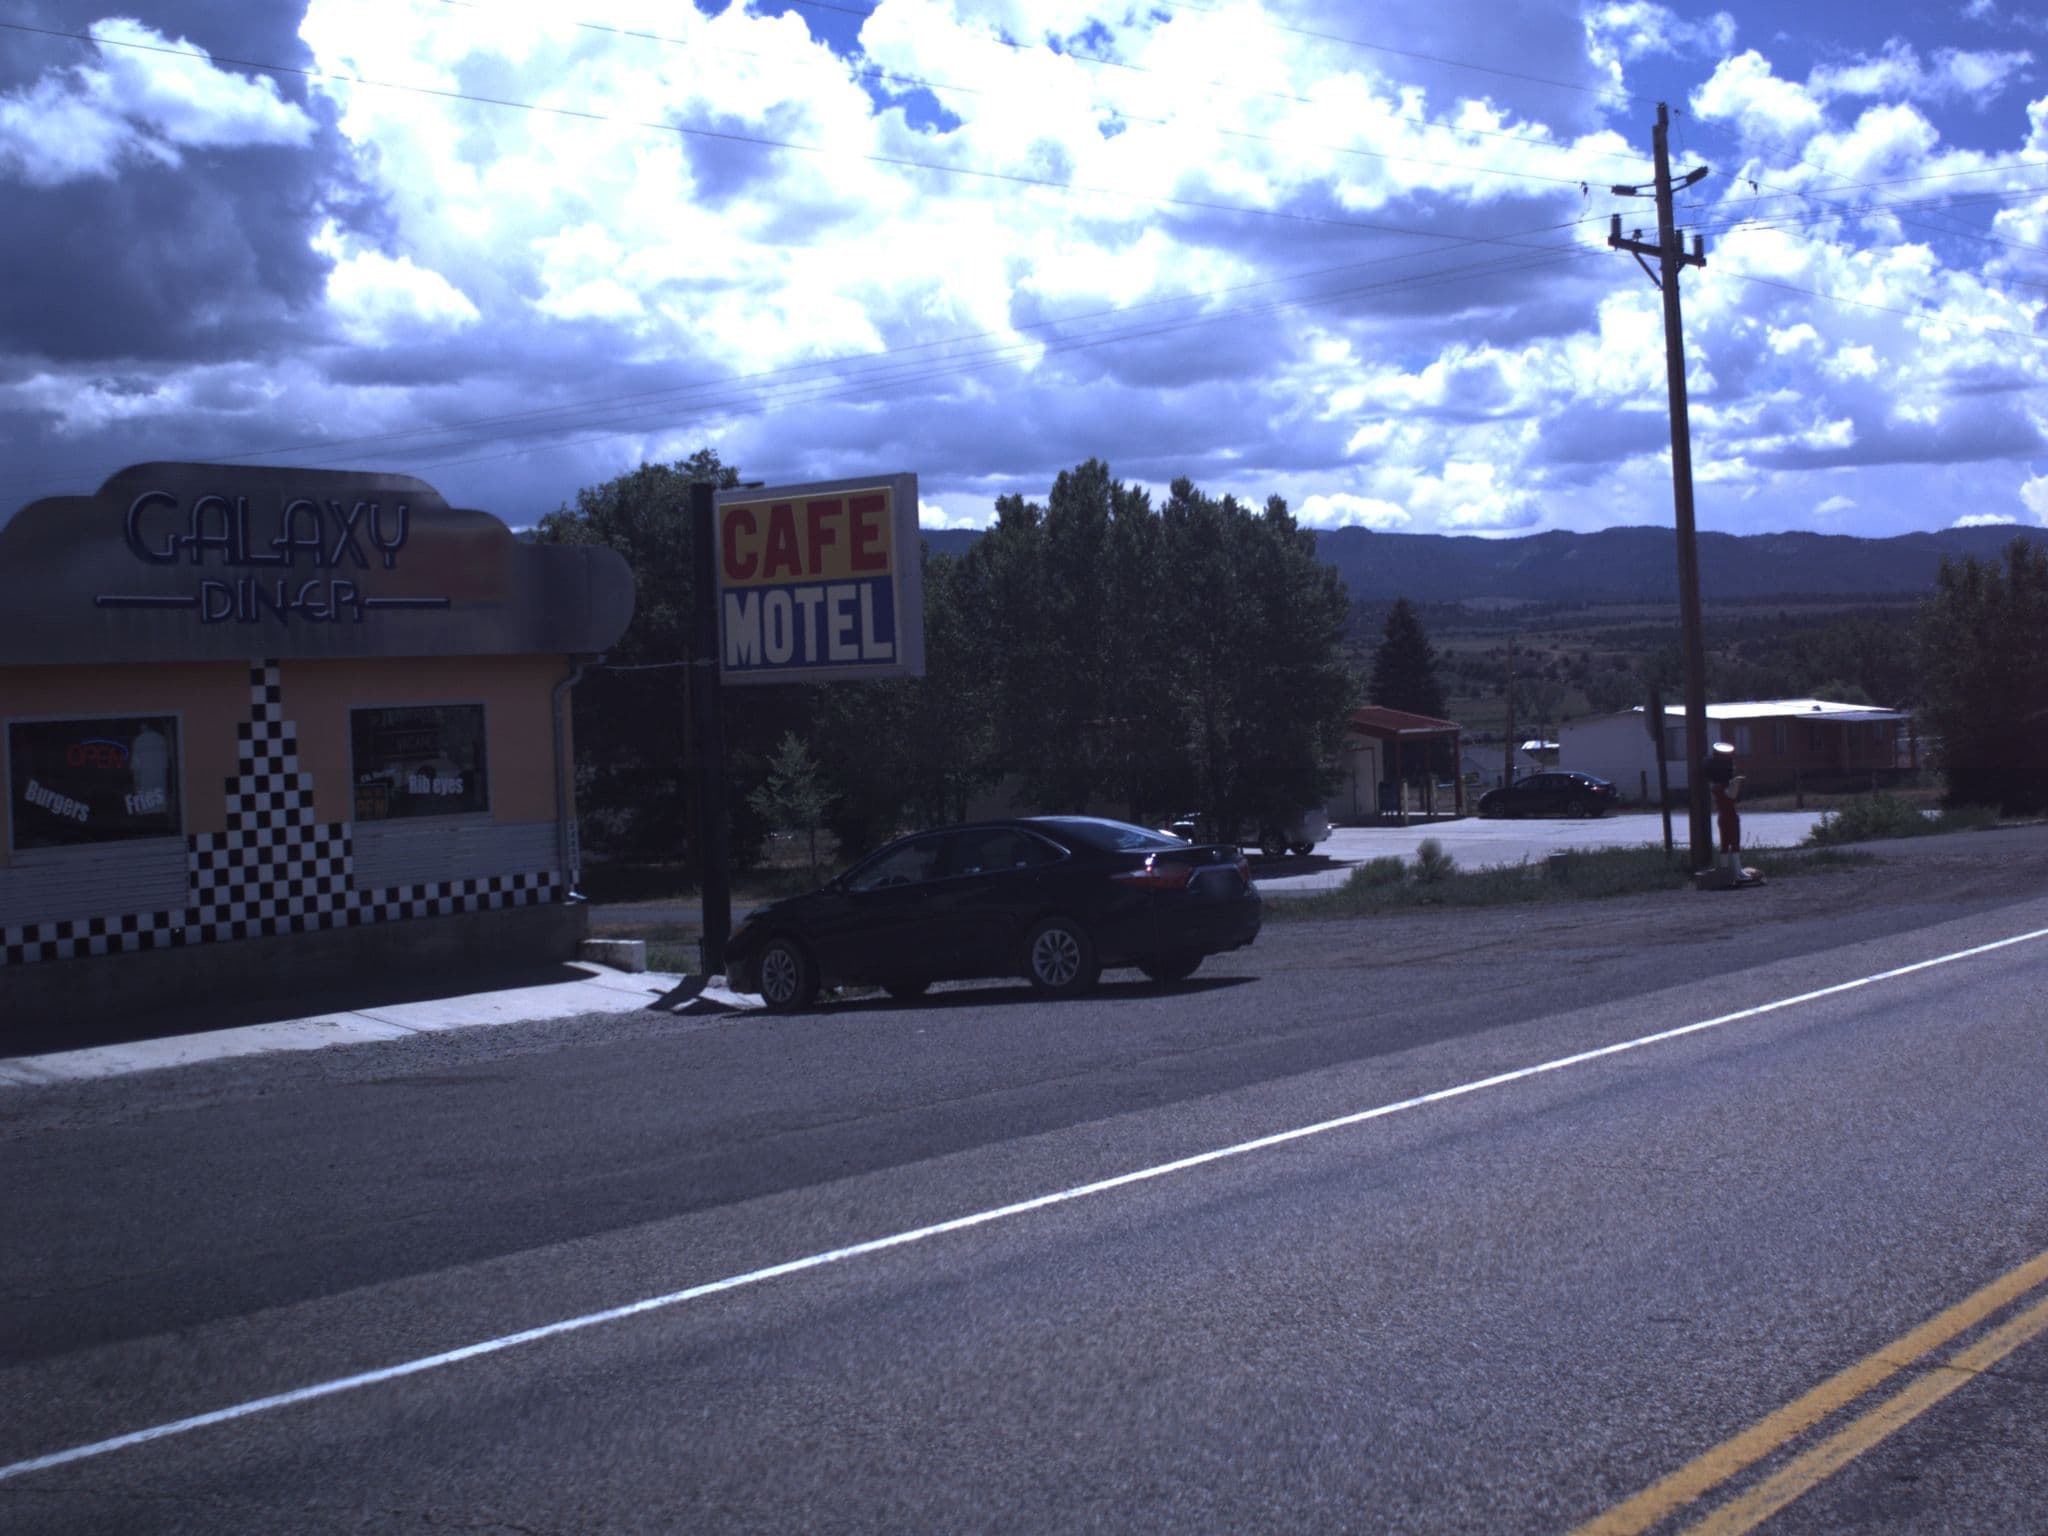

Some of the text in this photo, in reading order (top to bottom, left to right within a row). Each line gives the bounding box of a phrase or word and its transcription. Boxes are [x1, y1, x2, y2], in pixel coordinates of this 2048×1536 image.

[124, 489, 410, 569] GALAXY
[722, 494, 888, 580] CAFE
[200, 576, 363, 625] DINER
[724, 583, 893, 666] MOTEL
[67, 744, 125, 769] OPEN
[24, 779, 91, 823] Burgers
[124, 787, 165, 816] Fries
[408, 774, 431, 795] Rib
[432, 777, 464, 797] eyes
